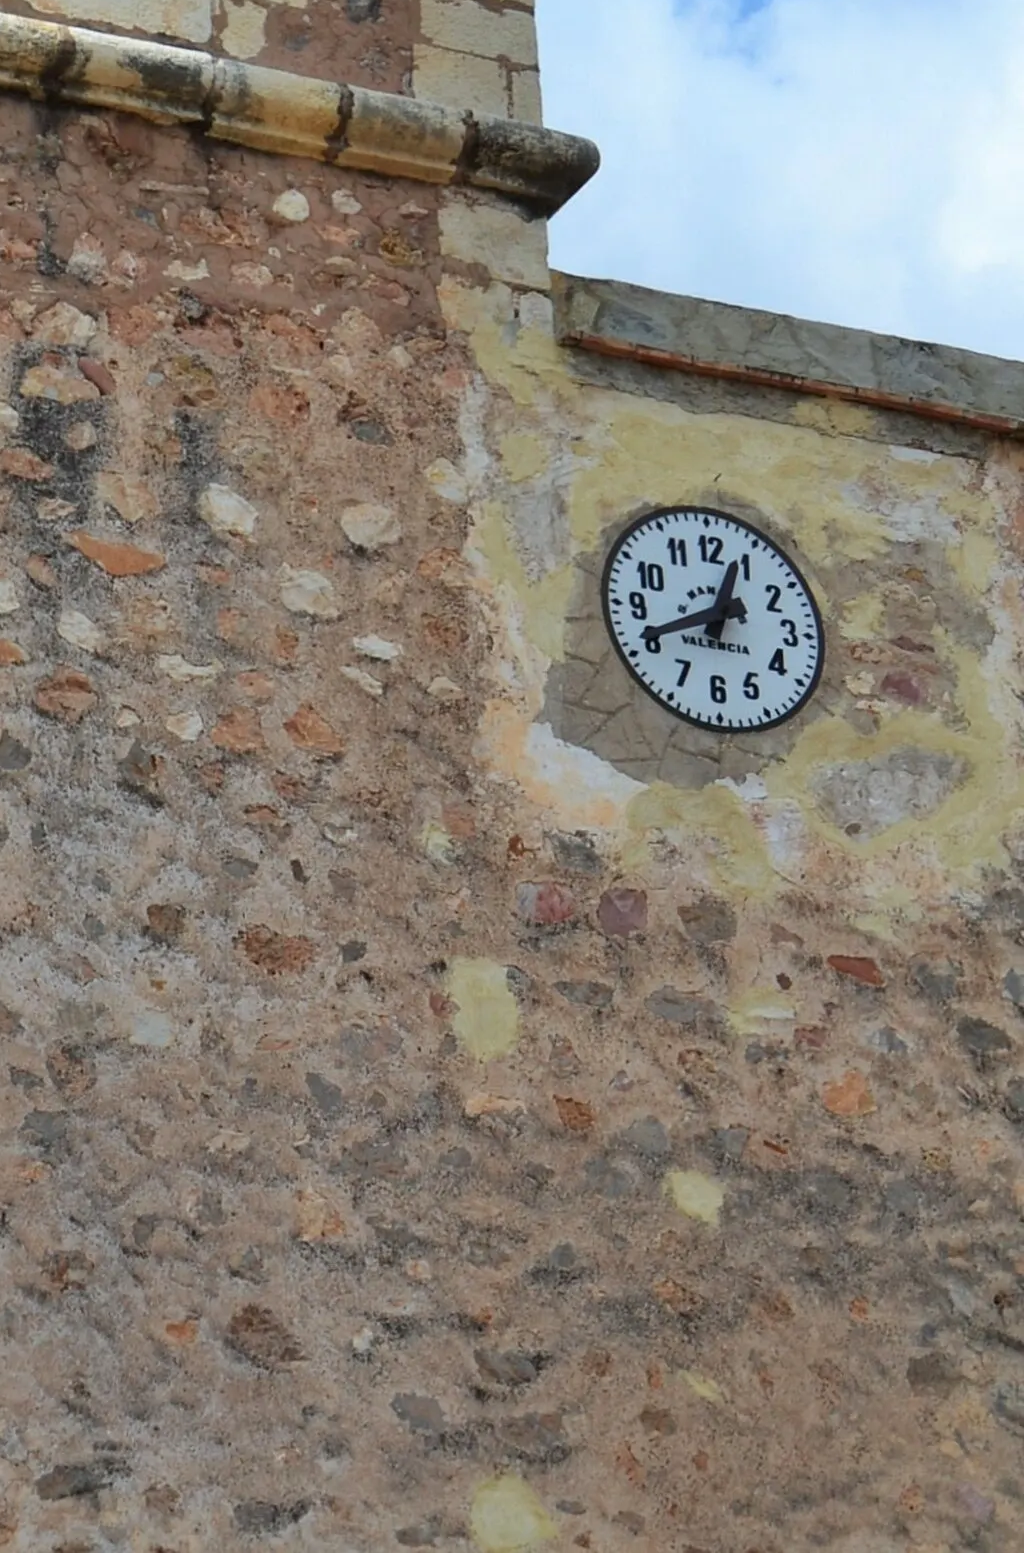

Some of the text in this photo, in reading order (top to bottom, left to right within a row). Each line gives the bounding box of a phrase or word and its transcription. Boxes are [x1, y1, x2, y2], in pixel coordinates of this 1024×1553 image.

[667, 537, 687, 567] 11
[698, 535, 725, 565] 12
[637, 561, 664, 592] 10
[741, 554, 751, 581] 1
[629, 591, 647, 620] 9
[766, 584, 782, 613] 2
[644, 625, 661, 654] 8
[681, 634, 750, 655] VALENCIA
[780, 619, 799, 647] 3
[675, 658, 691, 687] 7
[768, 648, 787, 676] 4
[710, 675, 727, 703] 6
[743, 672, 760, 700] 5
